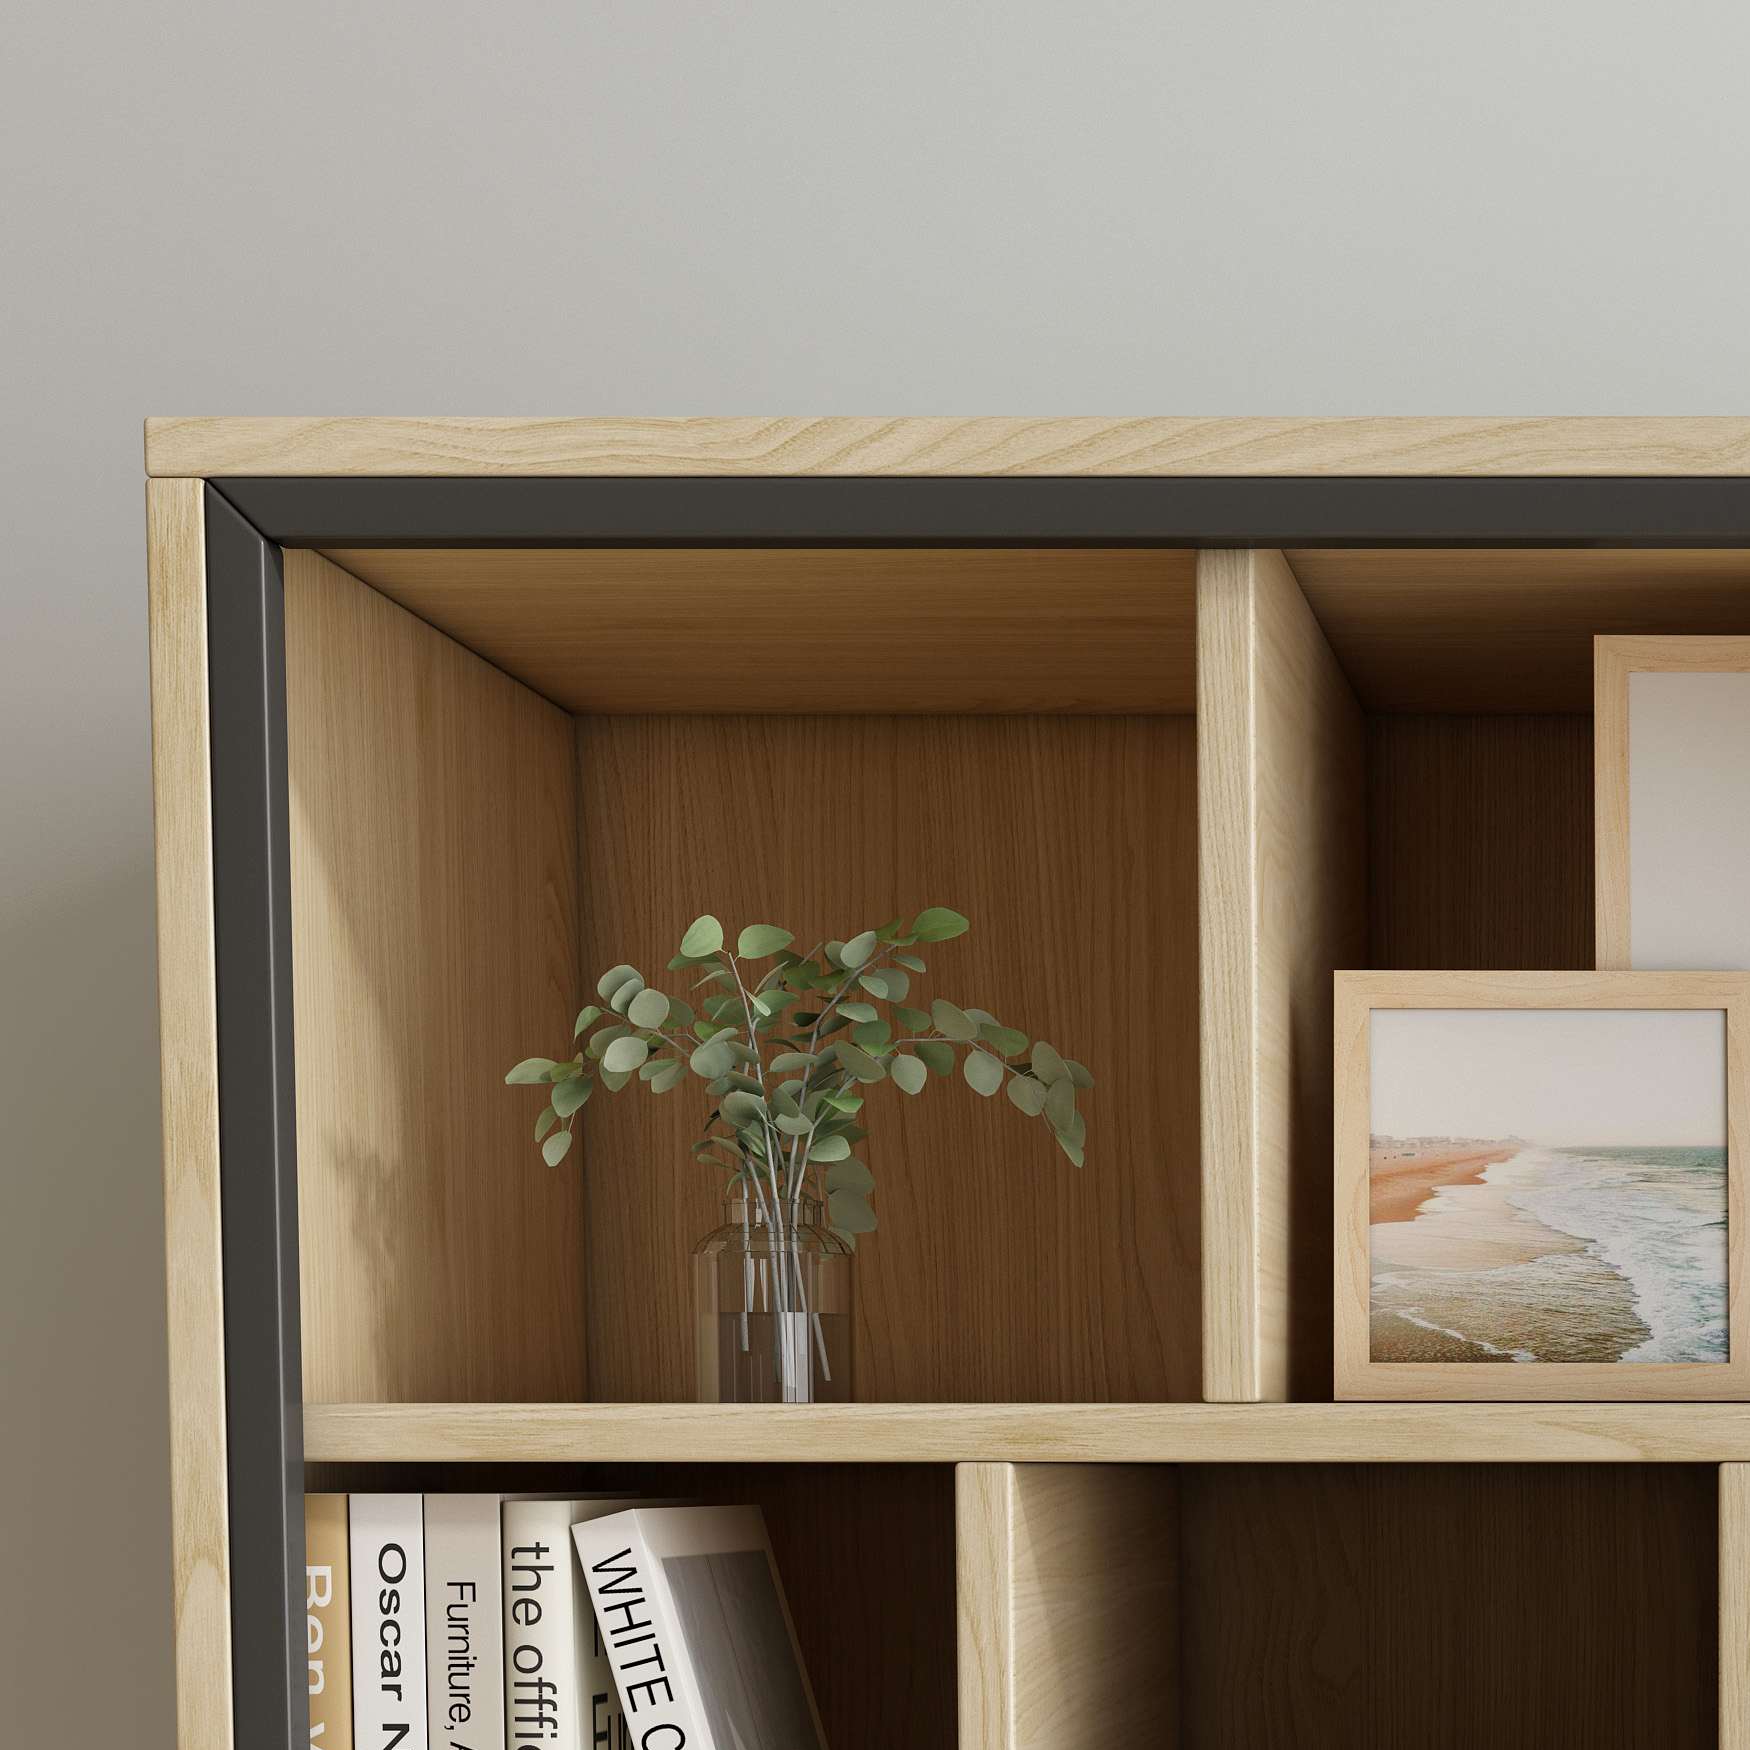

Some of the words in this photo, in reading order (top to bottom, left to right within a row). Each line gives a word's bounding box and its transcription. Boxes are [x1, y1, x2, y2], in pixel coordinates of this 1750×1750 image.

[378, 1542, 407, 1702] Oscar
[444, 1581, 476, 1731] Furniture,
[511, 1541, 555, 1626] the
[592, 1548, 674, 1713] WHITE
